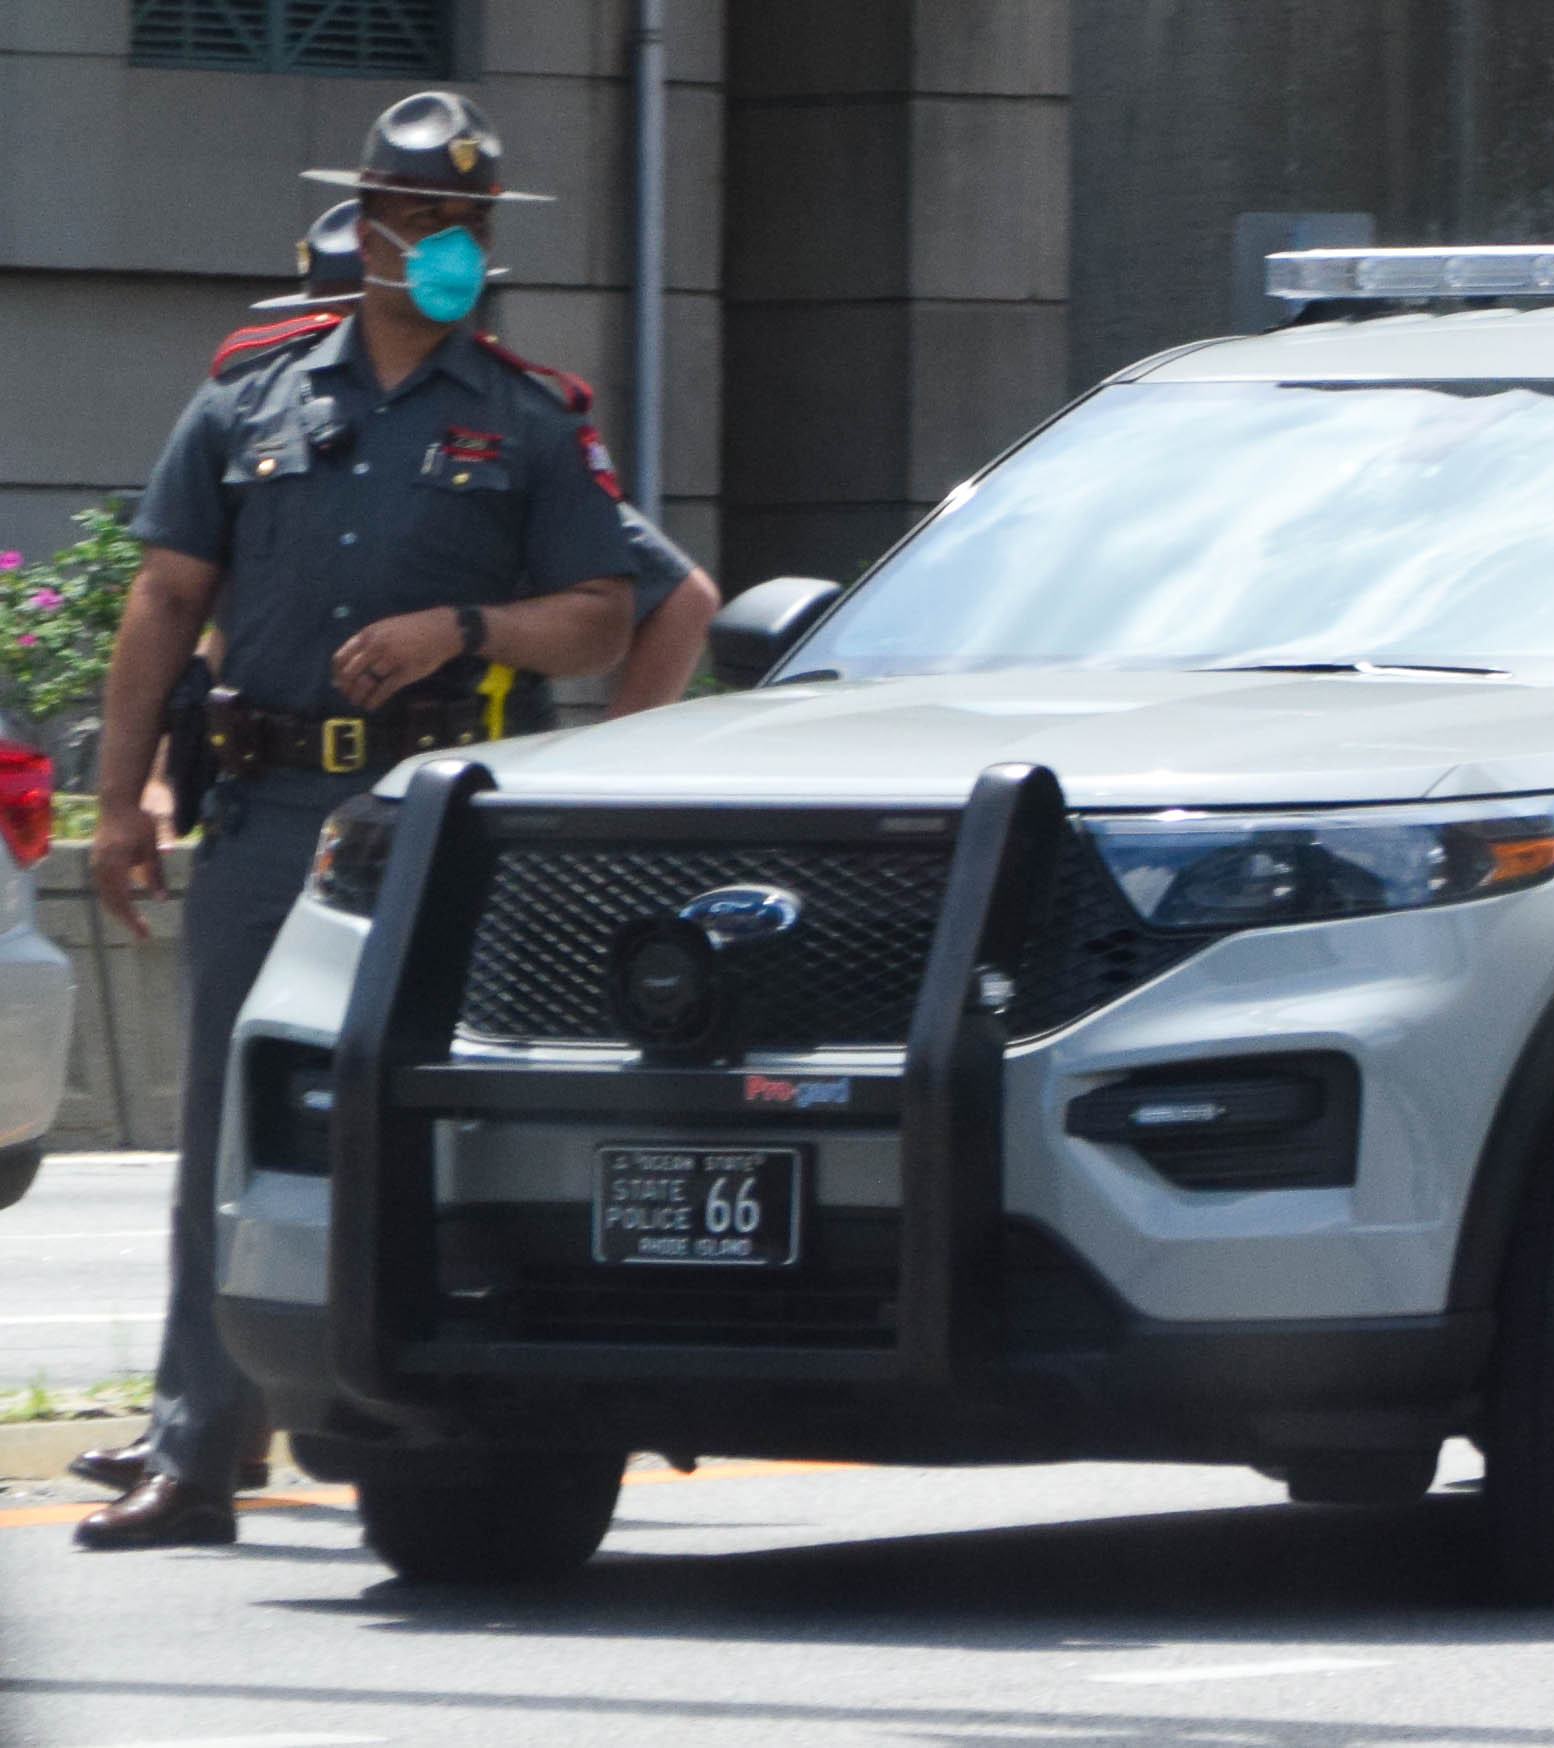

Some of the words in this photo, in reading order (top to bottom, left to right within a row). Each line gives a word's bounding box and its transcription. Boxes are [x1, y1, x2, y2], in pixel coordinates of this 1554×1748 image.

[612, 1178, 686, 1201] STATE
[705, 1176, 760, 1234] 66
[604, 1207, 693, 1231] POLICE
